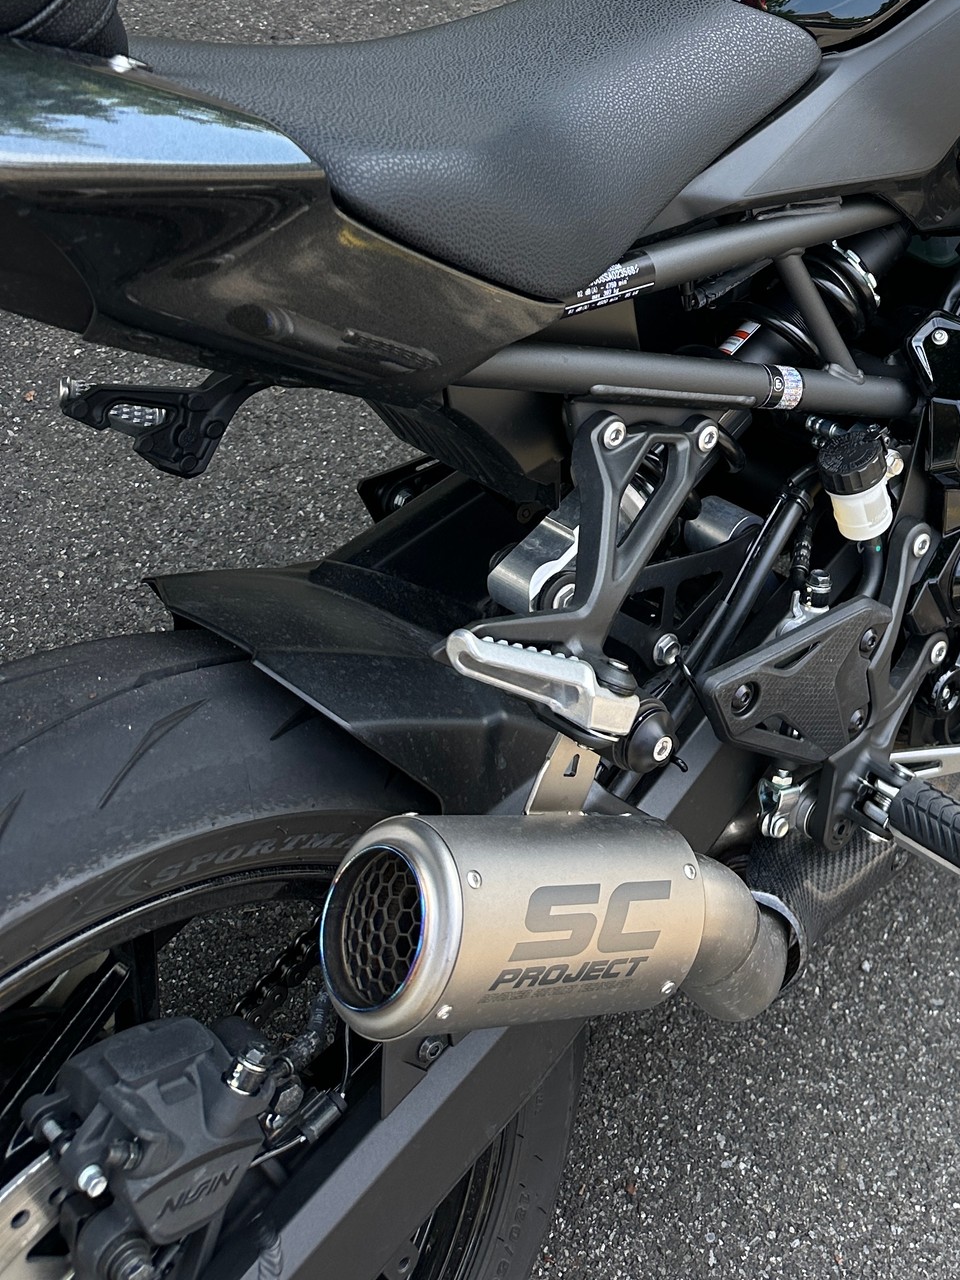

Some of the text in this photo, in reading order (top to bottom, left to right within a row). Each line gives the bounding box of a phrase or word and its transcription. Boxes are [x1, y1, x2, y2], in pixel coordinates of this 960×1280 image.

[508, 880, 672, 962] SC
[488, 956, 649, 992] PROJECT
[156, 1164, 239, 1220] NISSIN
